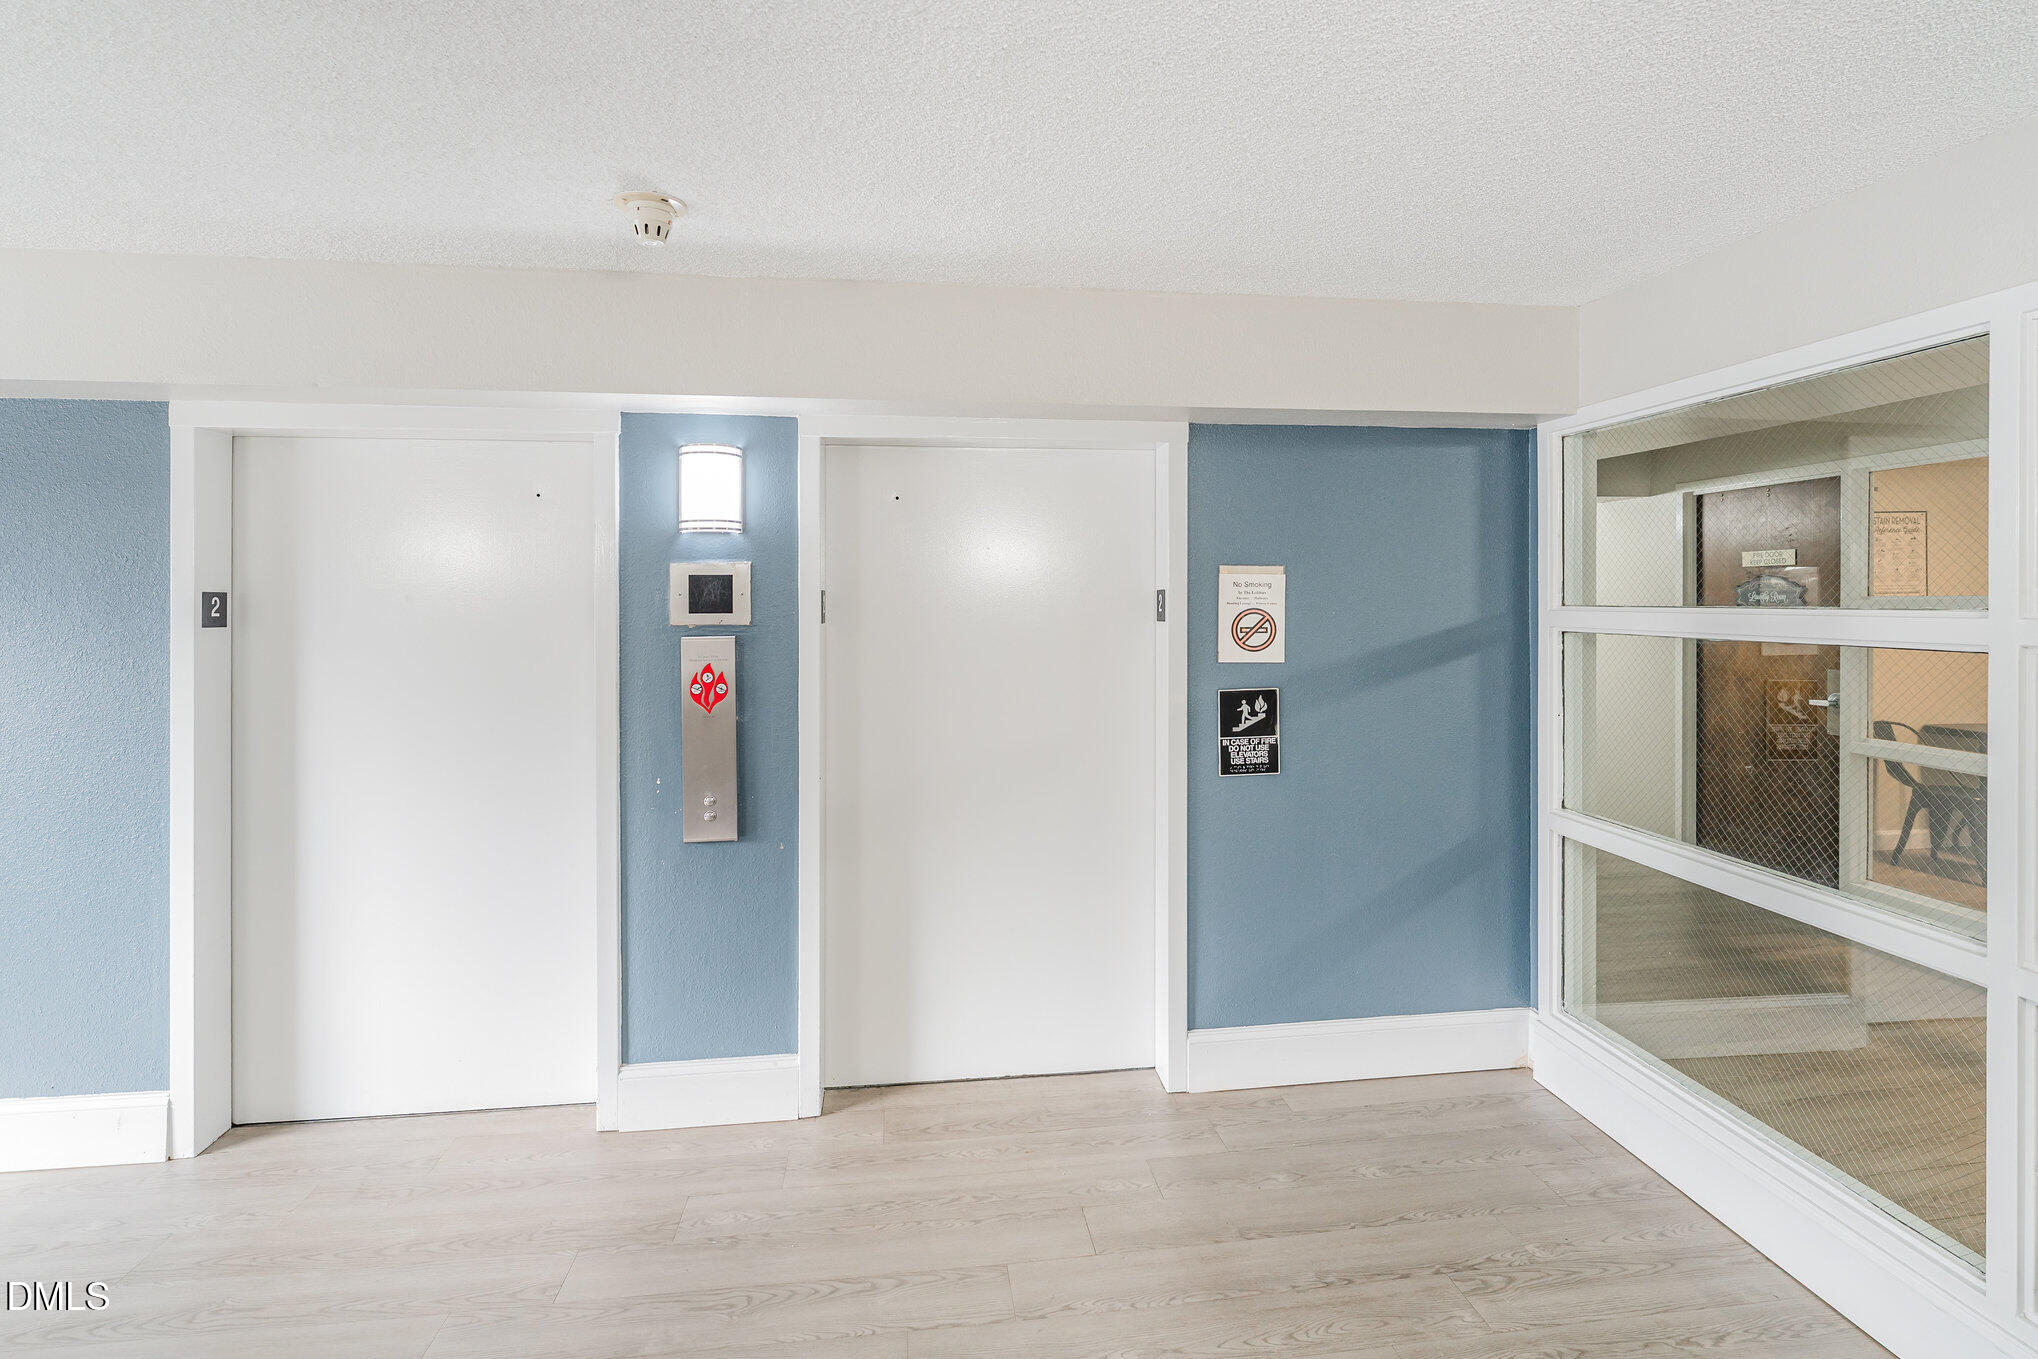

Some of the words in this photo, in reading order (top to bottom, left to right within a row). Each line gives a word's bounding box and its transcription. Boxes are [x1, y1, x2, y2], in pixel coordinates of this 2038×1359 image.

[1891, 516, 1920, 525] REMOVAL
[1244, 581, 1272, 590] Smoking
[211, 596, 220, 617] 2
[1159, 594, 1162, 611] 2
